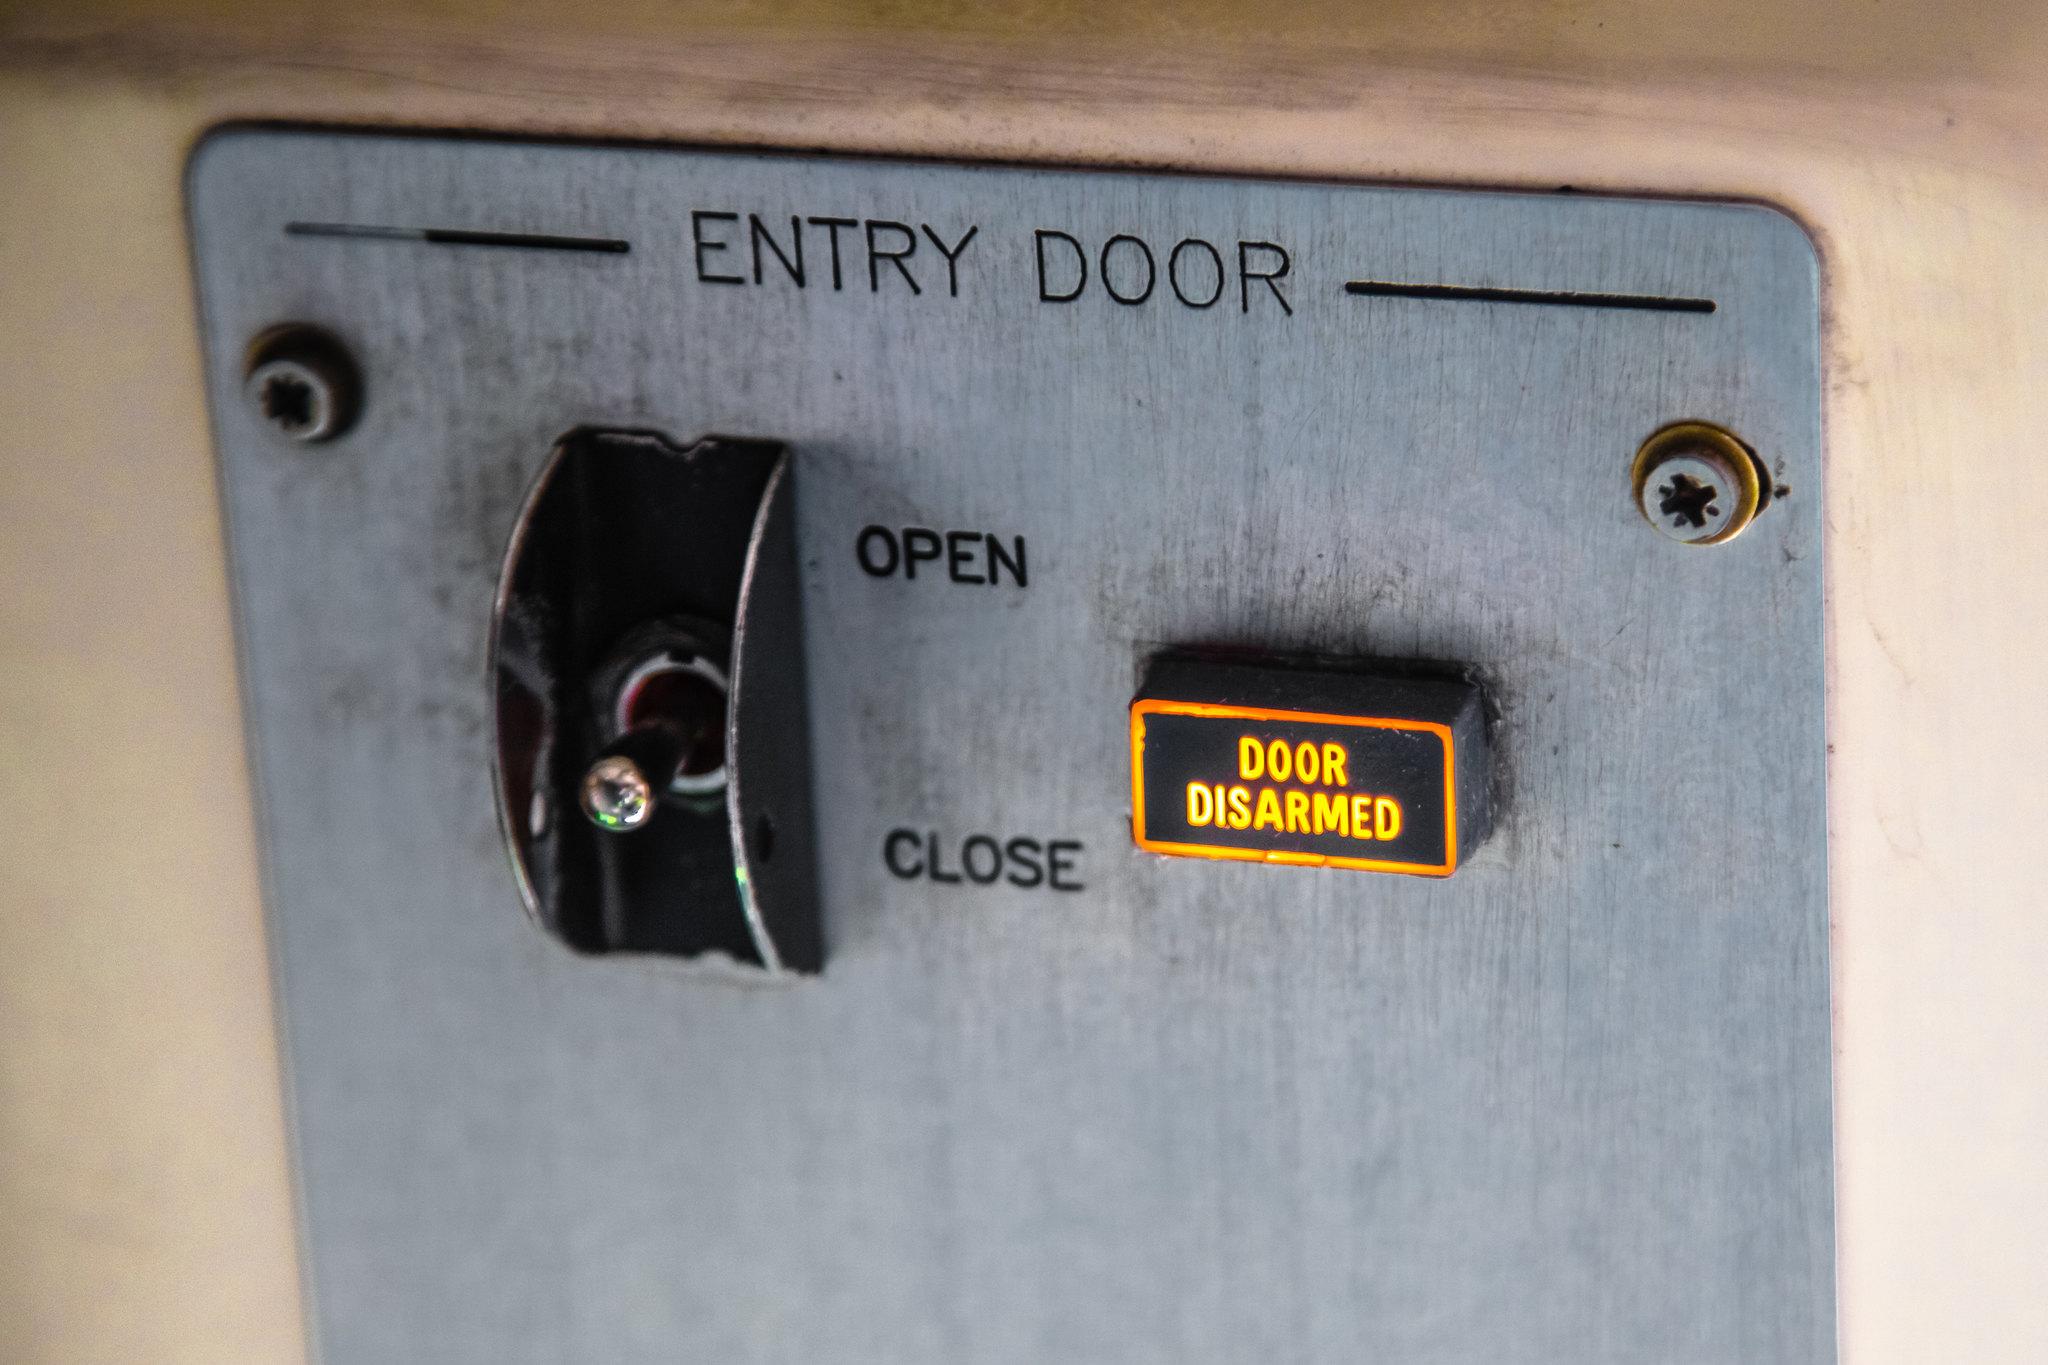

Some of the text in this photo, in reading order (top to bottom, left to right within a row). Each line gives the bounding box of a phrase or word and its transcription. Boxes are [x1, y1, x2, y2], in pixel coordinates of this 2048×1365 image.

[691, 211, 1293, 317] ENTRY DOOR
[855, 524, 1029, 588] OPEN
[1238, 735, 1350, 787] DOOR
[1185, 780, 1404, 842] DISARMED
[883, 827, 1085, 892] CLOSE
